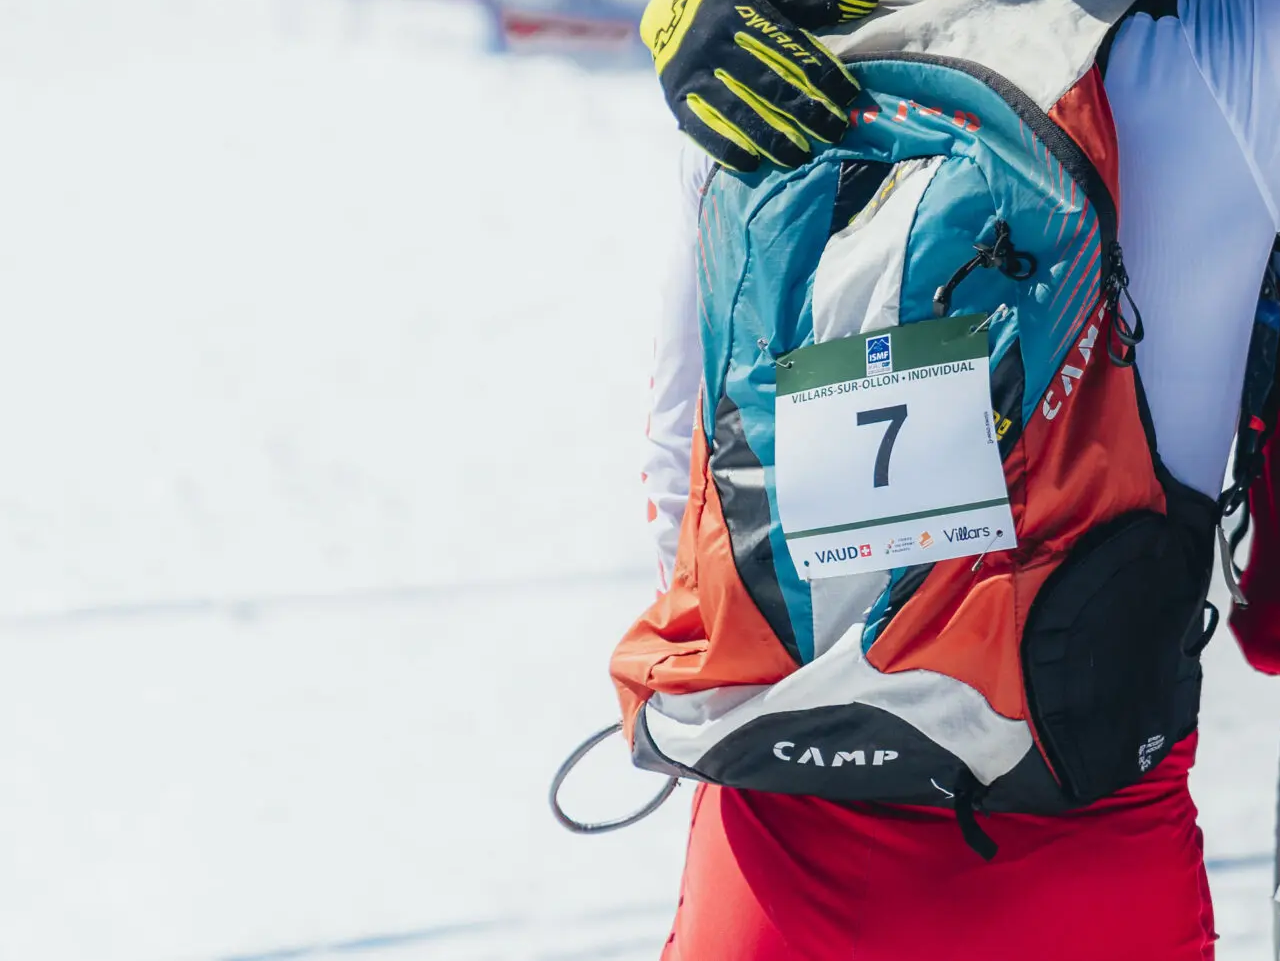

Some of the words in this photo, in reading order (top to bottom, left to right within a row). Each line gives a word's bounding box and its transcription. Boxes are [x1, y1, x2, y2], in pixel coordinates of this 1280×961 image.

[734, 4, 823, 67] DYNAFIT
[869, 350, 889, 362] ISMF
[791, 374, 900, 405] VILLARS-SUR-OLLON
[907, 360, 975, 381] INDIVIDUAL
[856, 403, 908, 488] 7
[943, 526, 991, 543] Villars
[814, 546, 859, 564] VAUD
[772, 741, 899, 767] CAMP
